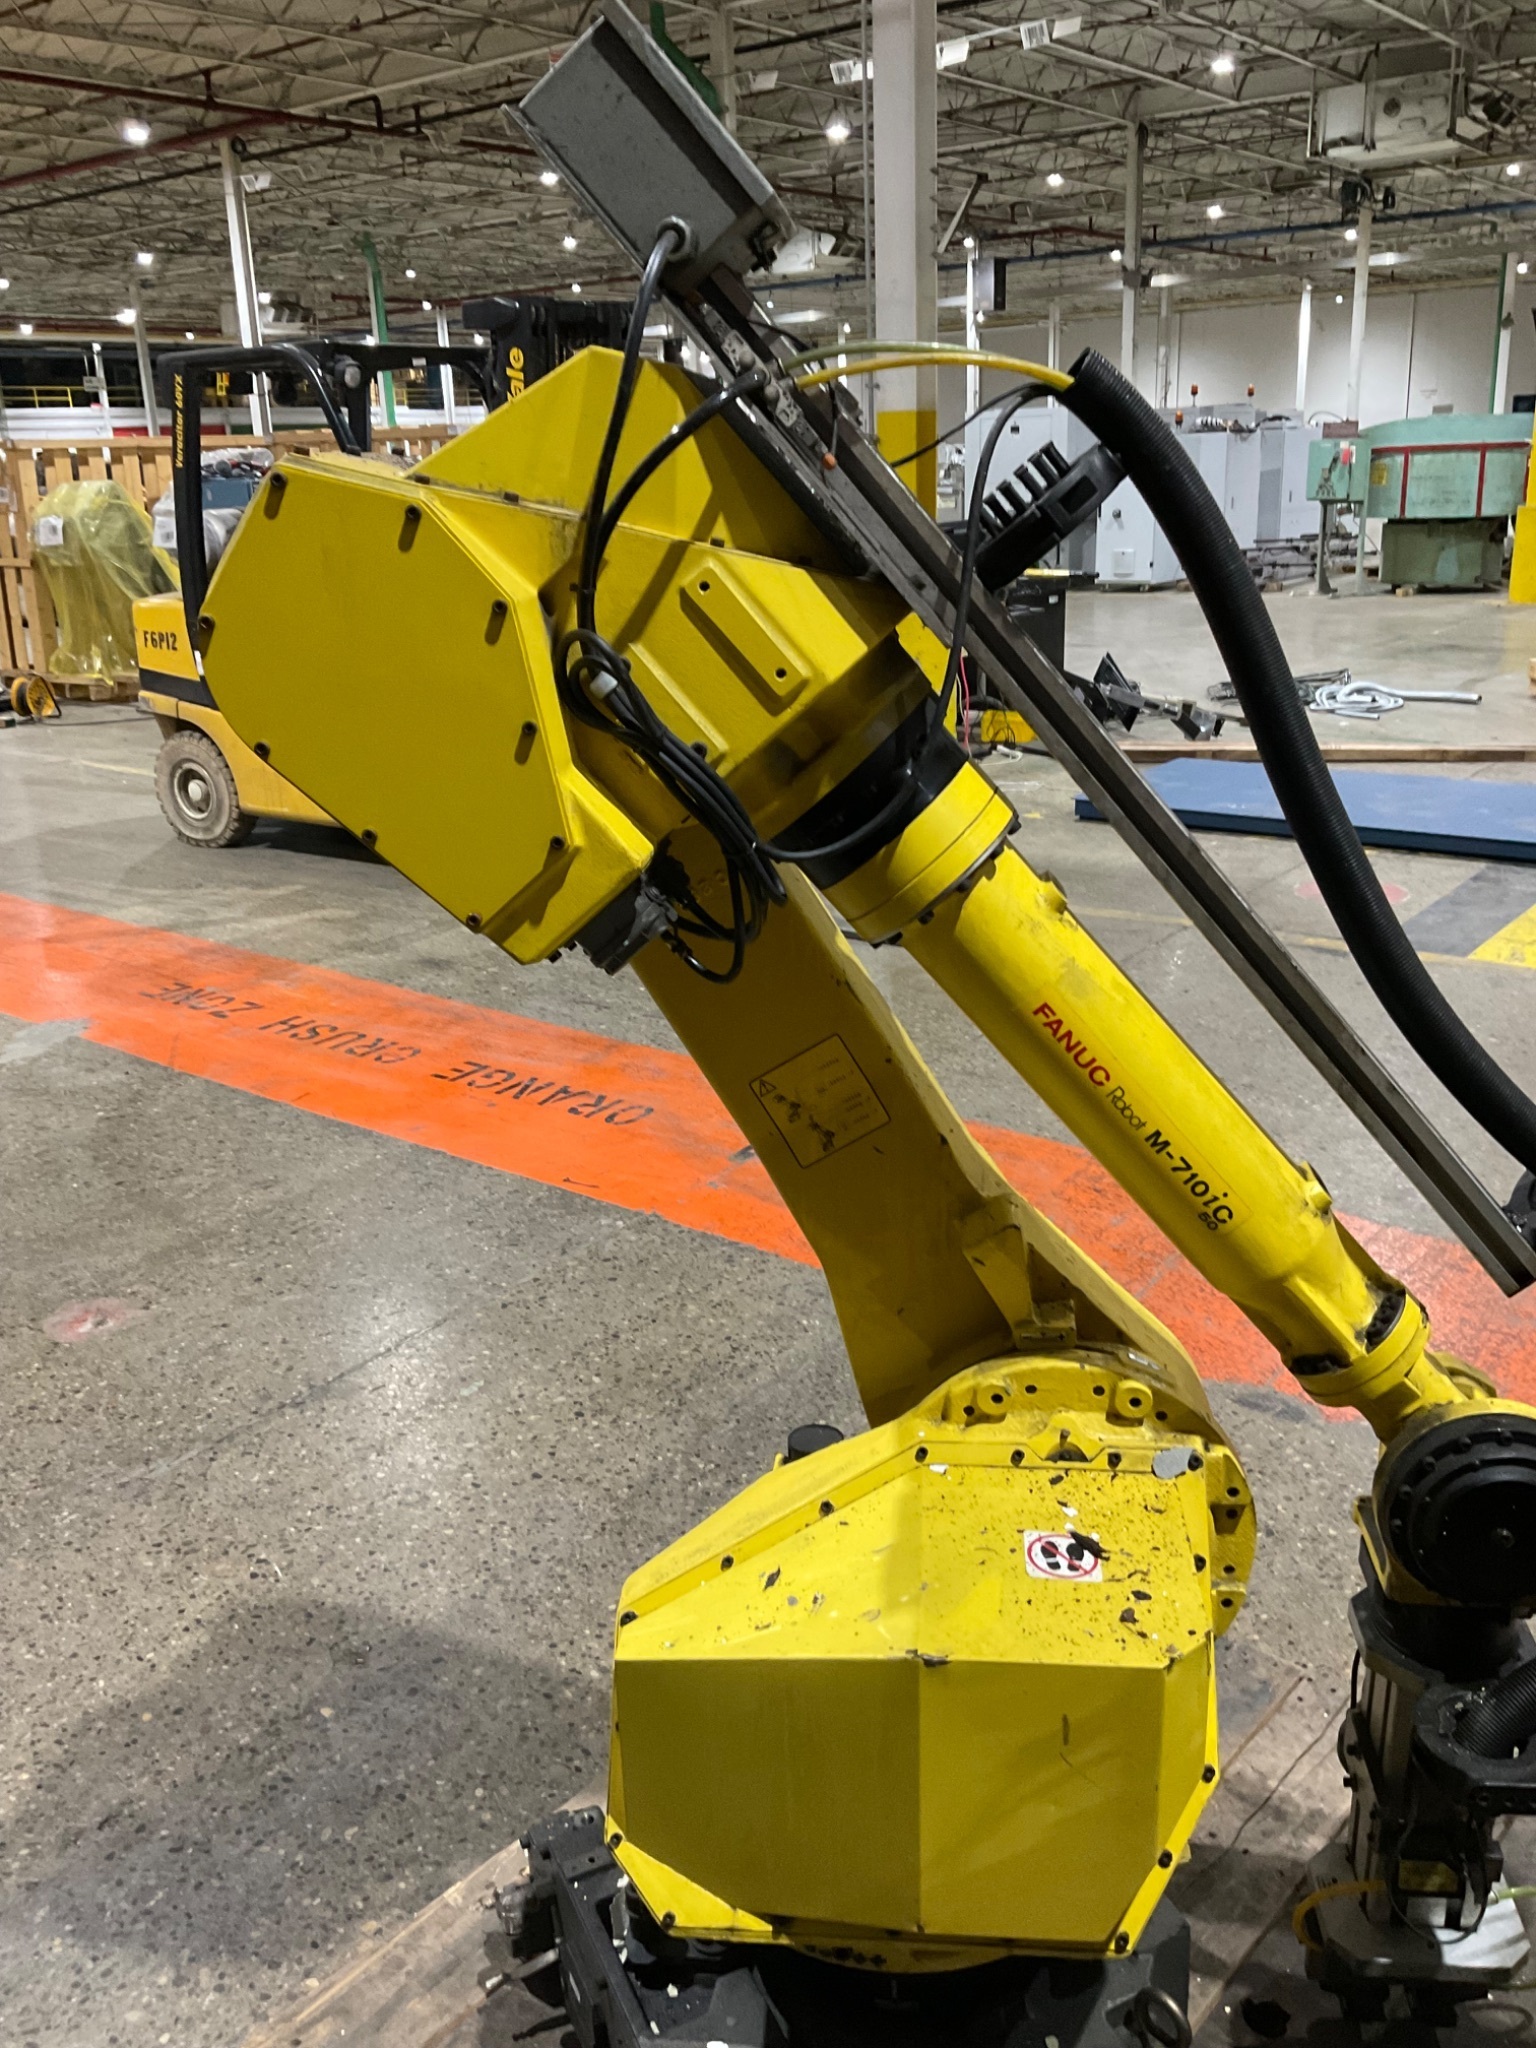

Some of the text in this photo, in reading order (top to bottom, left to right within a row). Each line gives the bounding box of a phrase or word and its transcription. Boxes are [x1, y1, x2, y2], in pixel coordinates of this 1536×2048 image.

[505, 346, 525, 403] ale
[174, 410, 184, 468] Veracitor
[138, 981, 655, 1126] ORANGE CRUSH ZONE
[1032, 1002, 1234, 1225] FANUC Robot M-710iC
[1197, 1211, 1219, 1232] 50
